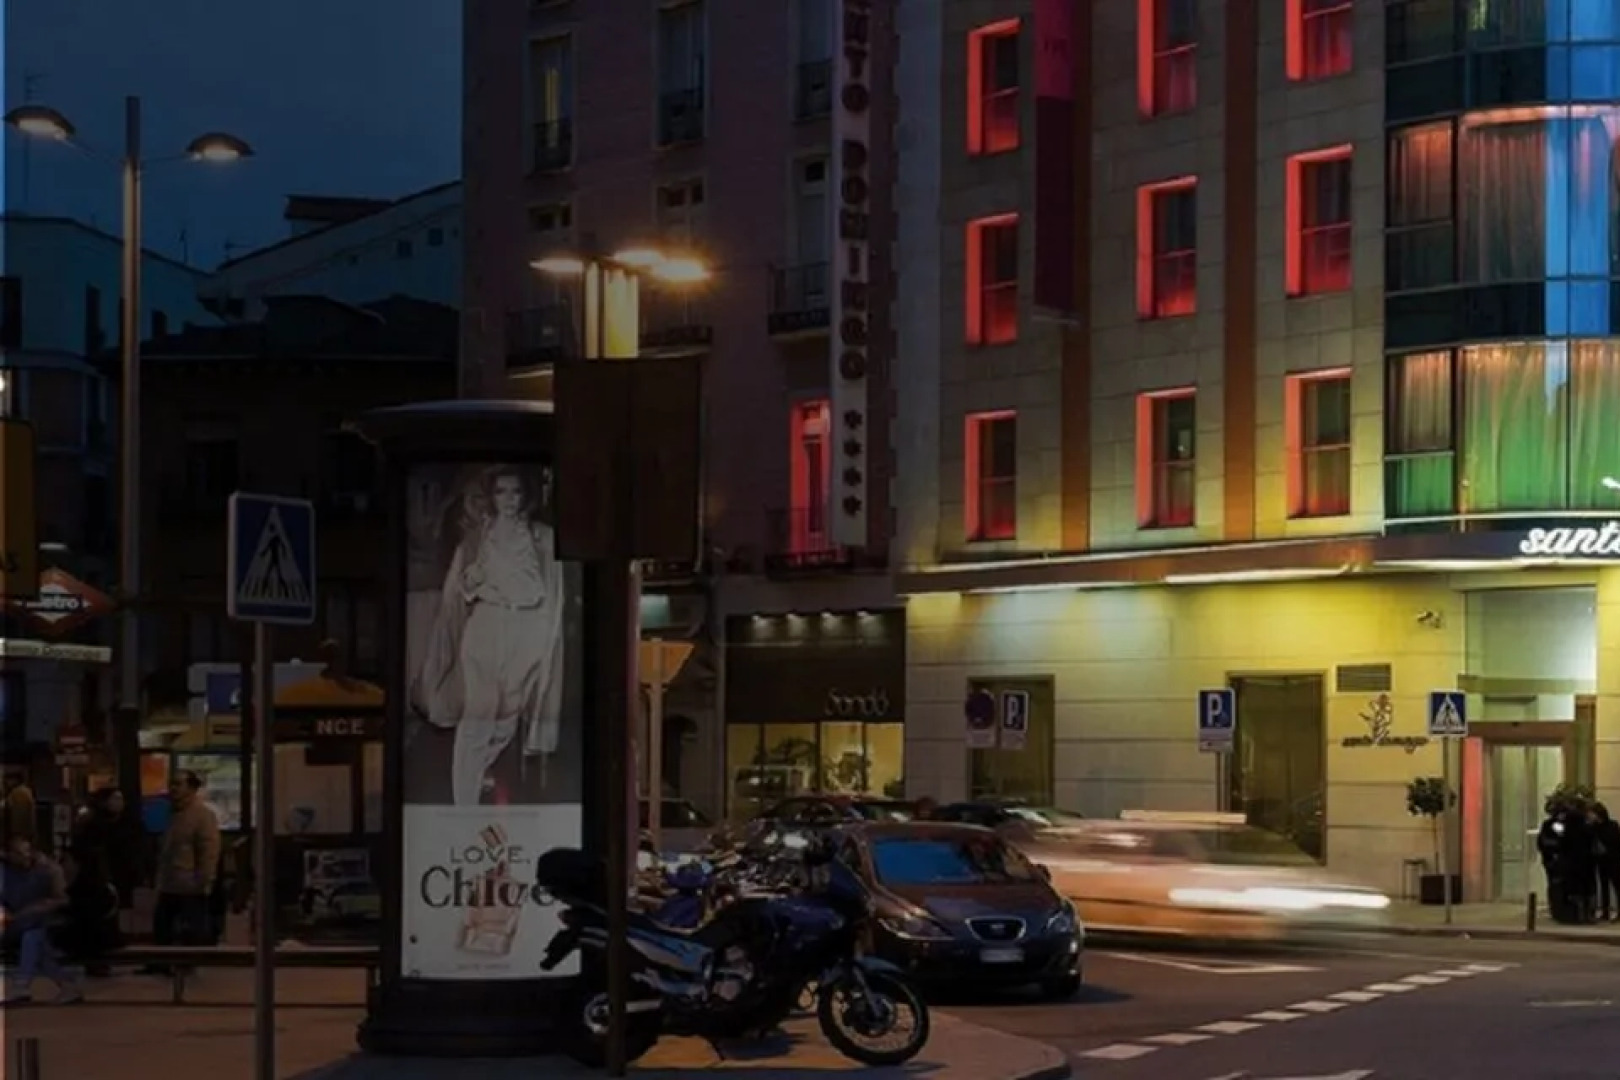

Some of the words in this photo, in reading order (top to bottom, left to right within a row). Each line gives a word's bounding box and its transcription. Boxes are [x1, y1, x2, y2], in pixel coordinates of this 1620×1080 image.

[842, 0, 868, 112] NTO
[839, 139, 868, 380] DOMINGO
[1206, 691, 1222, 727] P
